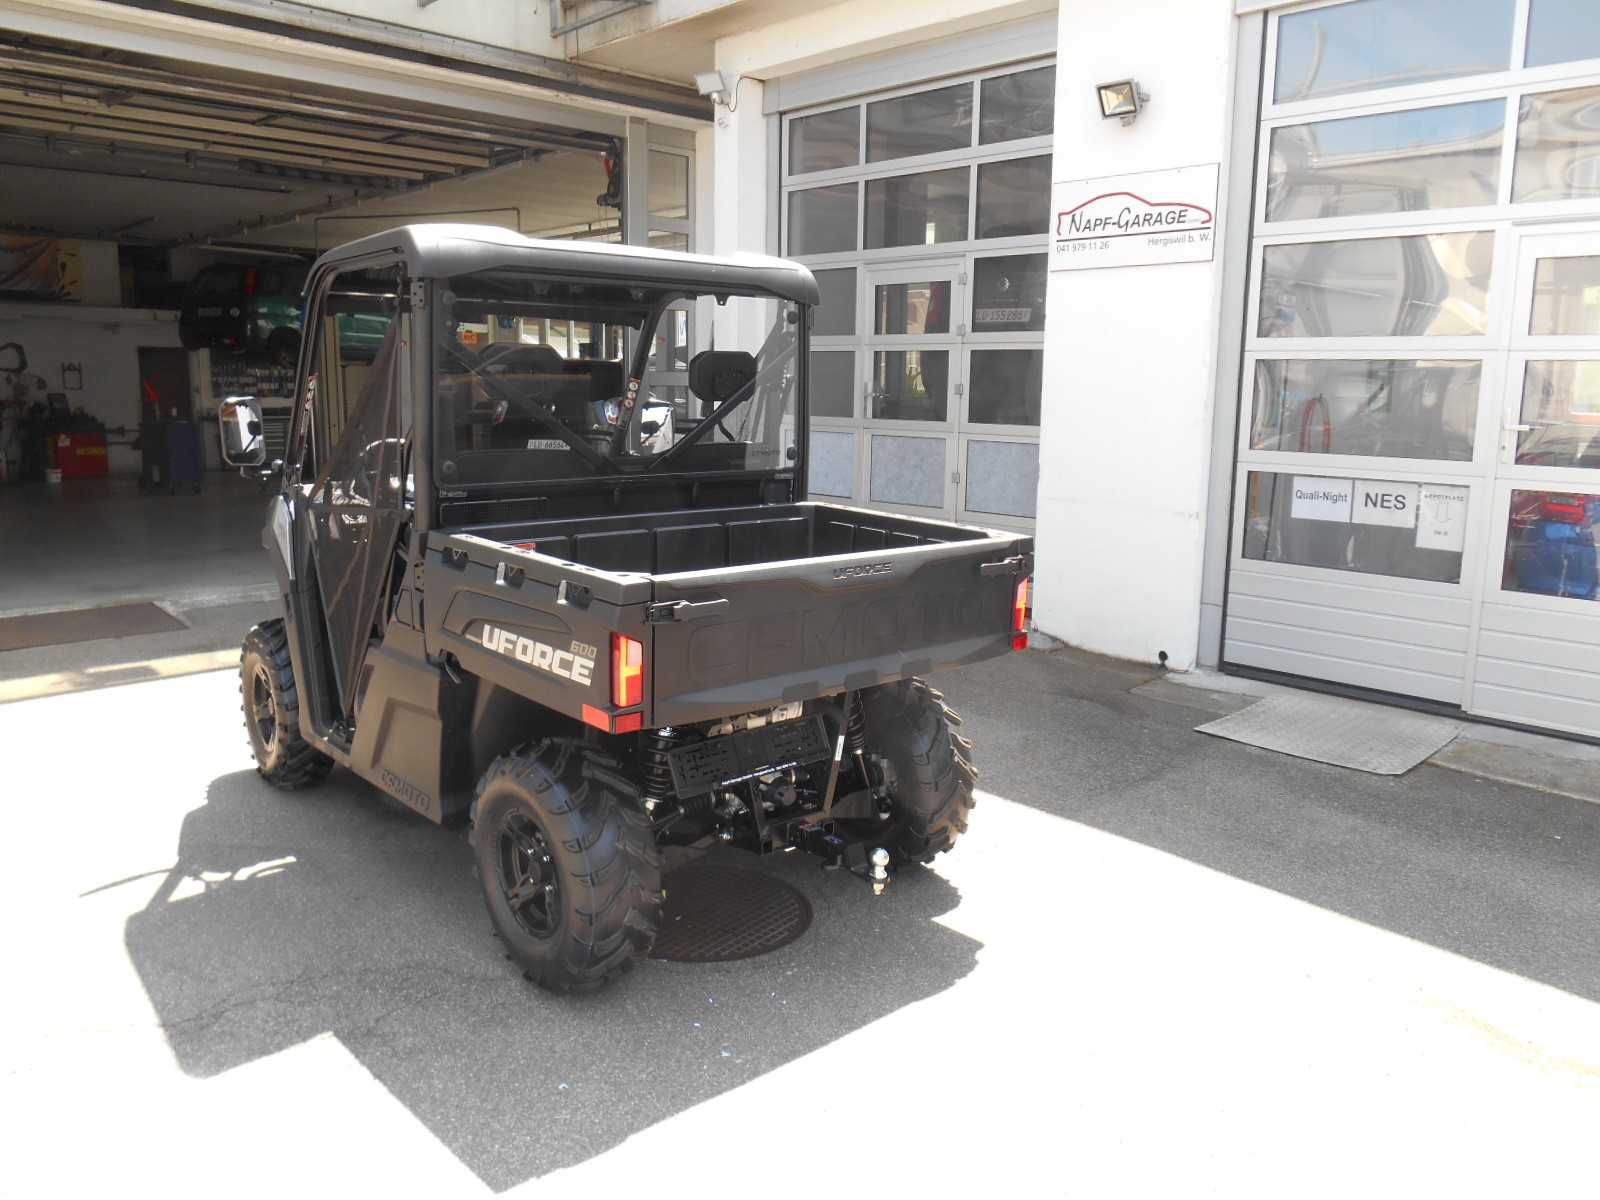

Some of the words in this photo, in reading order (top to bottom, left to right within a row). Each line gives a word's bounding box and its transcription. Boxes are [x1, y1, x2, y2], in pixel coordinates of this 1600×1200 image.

[1056, 244, 1070, 253] 041
[1072, 242, 1087, 252] 979
[1088, 242, 1097, 251] 11
[1099, 241, 1110, 250] 26
[1147, 234, 1187, 247] Hergiswil
[1199, 232, 1212, 242] W.
[1295, 489, 1348, 504] Quali-Night
[1364, 491, 1407, 511] NES
[833, 561, 893, 580] UFORCE
[481, 623, 595, 687] UFORCE
[570, 640, 598, 659] 600
